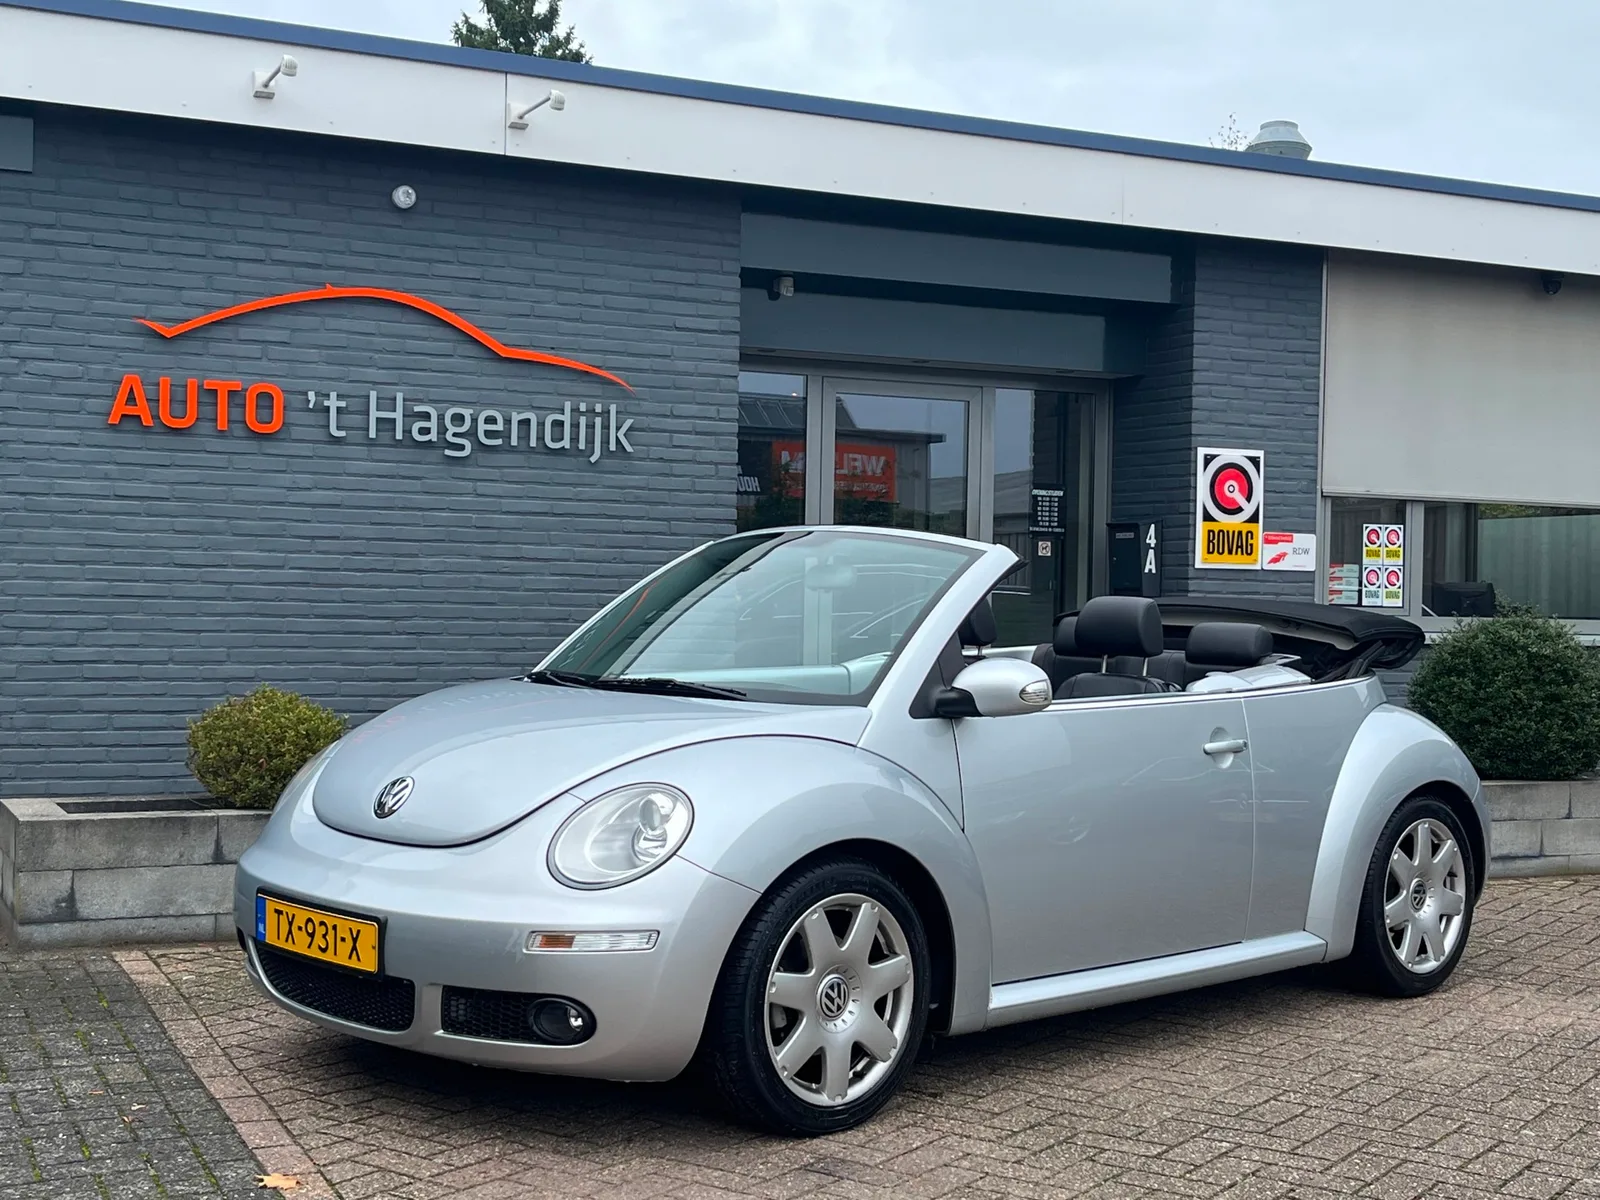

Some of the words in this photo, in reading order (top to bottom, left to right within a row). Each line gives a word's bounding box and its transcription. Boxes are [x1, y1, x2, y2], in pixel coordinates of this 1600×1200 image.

[107, 374, 285, 434] AUTO
[368, 390, 635, 464] Hagendijk
[1206, 529, 1254, 556] BOVAG
[1292, 547, 1310, 555] RDW
[273, 908, 362, 963] TX-931-X
